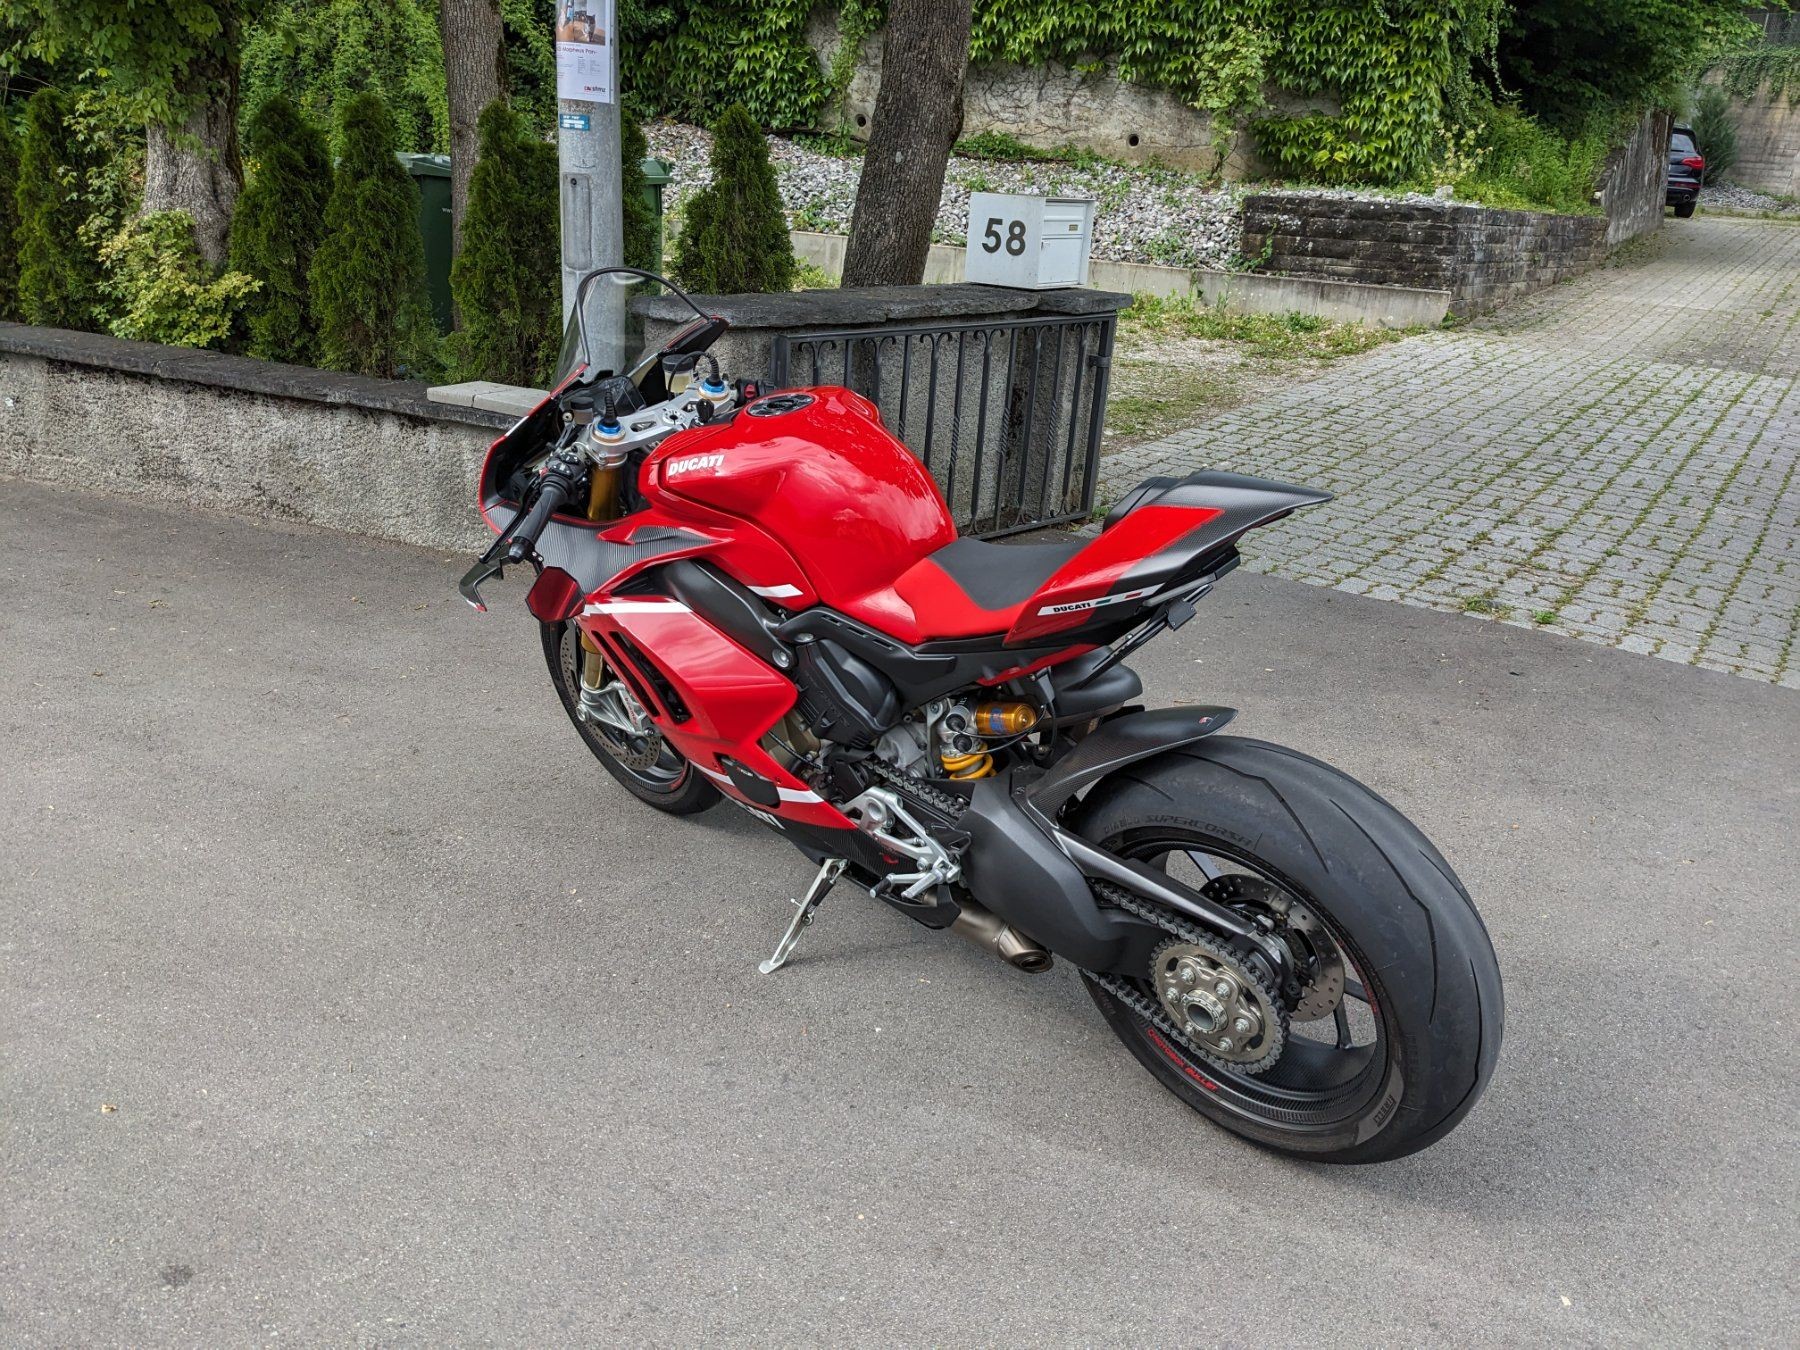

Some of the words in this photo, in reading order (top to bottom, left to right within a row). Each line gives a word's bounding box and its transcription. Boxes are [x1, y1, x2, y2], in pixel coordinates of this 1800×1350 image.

[981, 217, 1027, 257] 58
[668, 454, 725, 477] DUCATI
[1053, 602, 1091, 613] DUCATI
